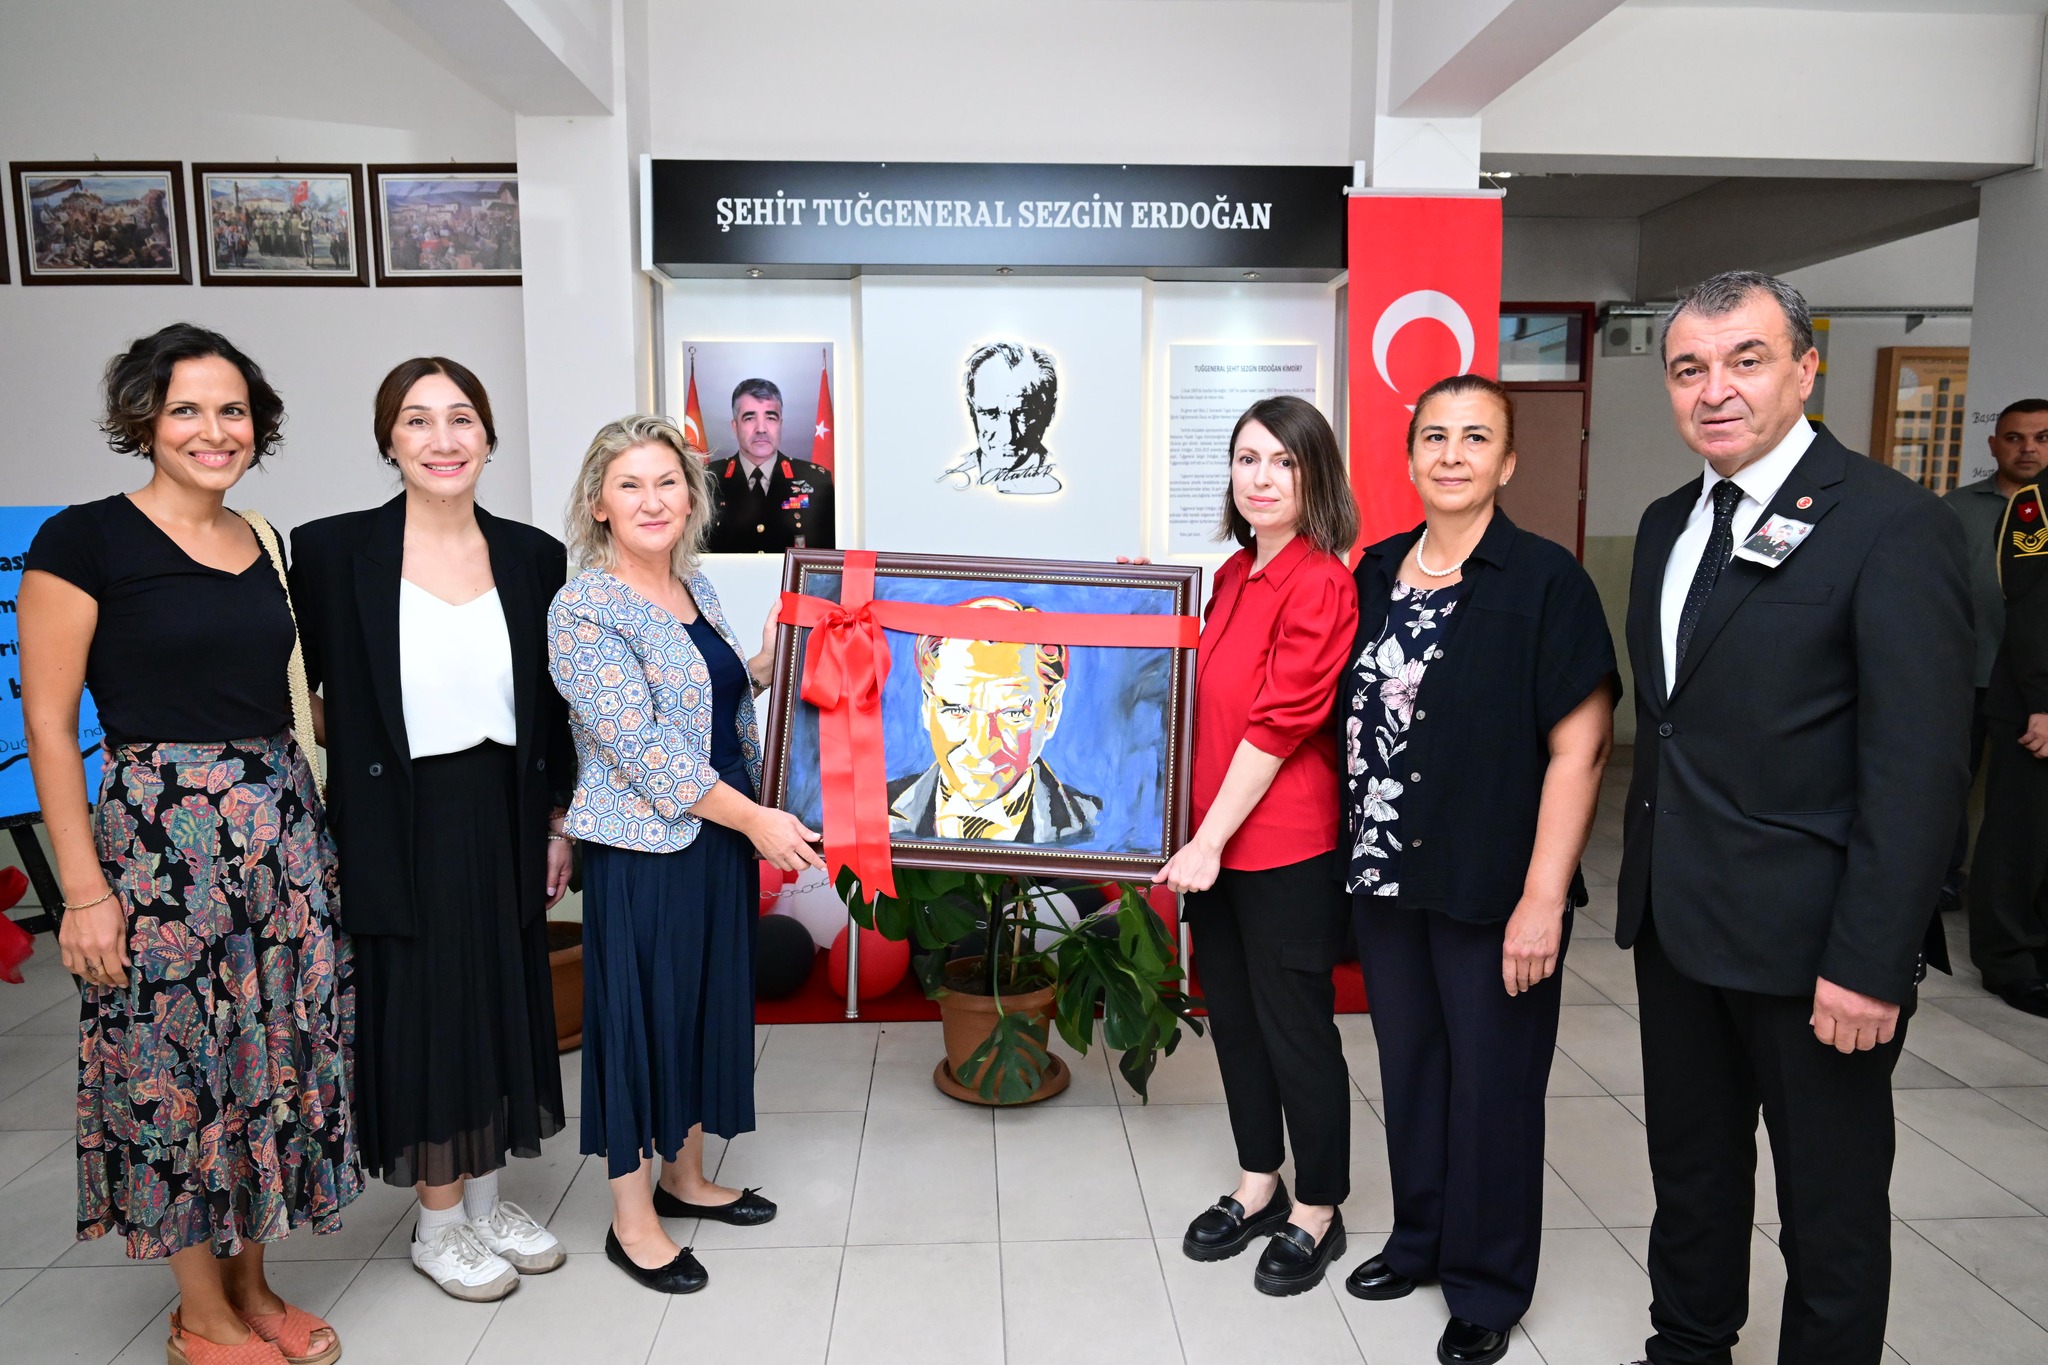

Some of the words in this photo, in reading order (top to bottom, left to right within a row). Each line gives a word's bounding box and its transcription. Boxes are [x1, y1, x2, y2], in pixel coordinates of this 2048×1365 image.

[716, 189, 806, 233] ŞEHİT
[812, 191, 1012, 228] TUĞGENERAL
[1018, 193, 1124, 229] SEZGİN
[1131, 195, 1273, 230] ERDOĞAN
[1257, 364, 1282, 373] ERDOĞAN
